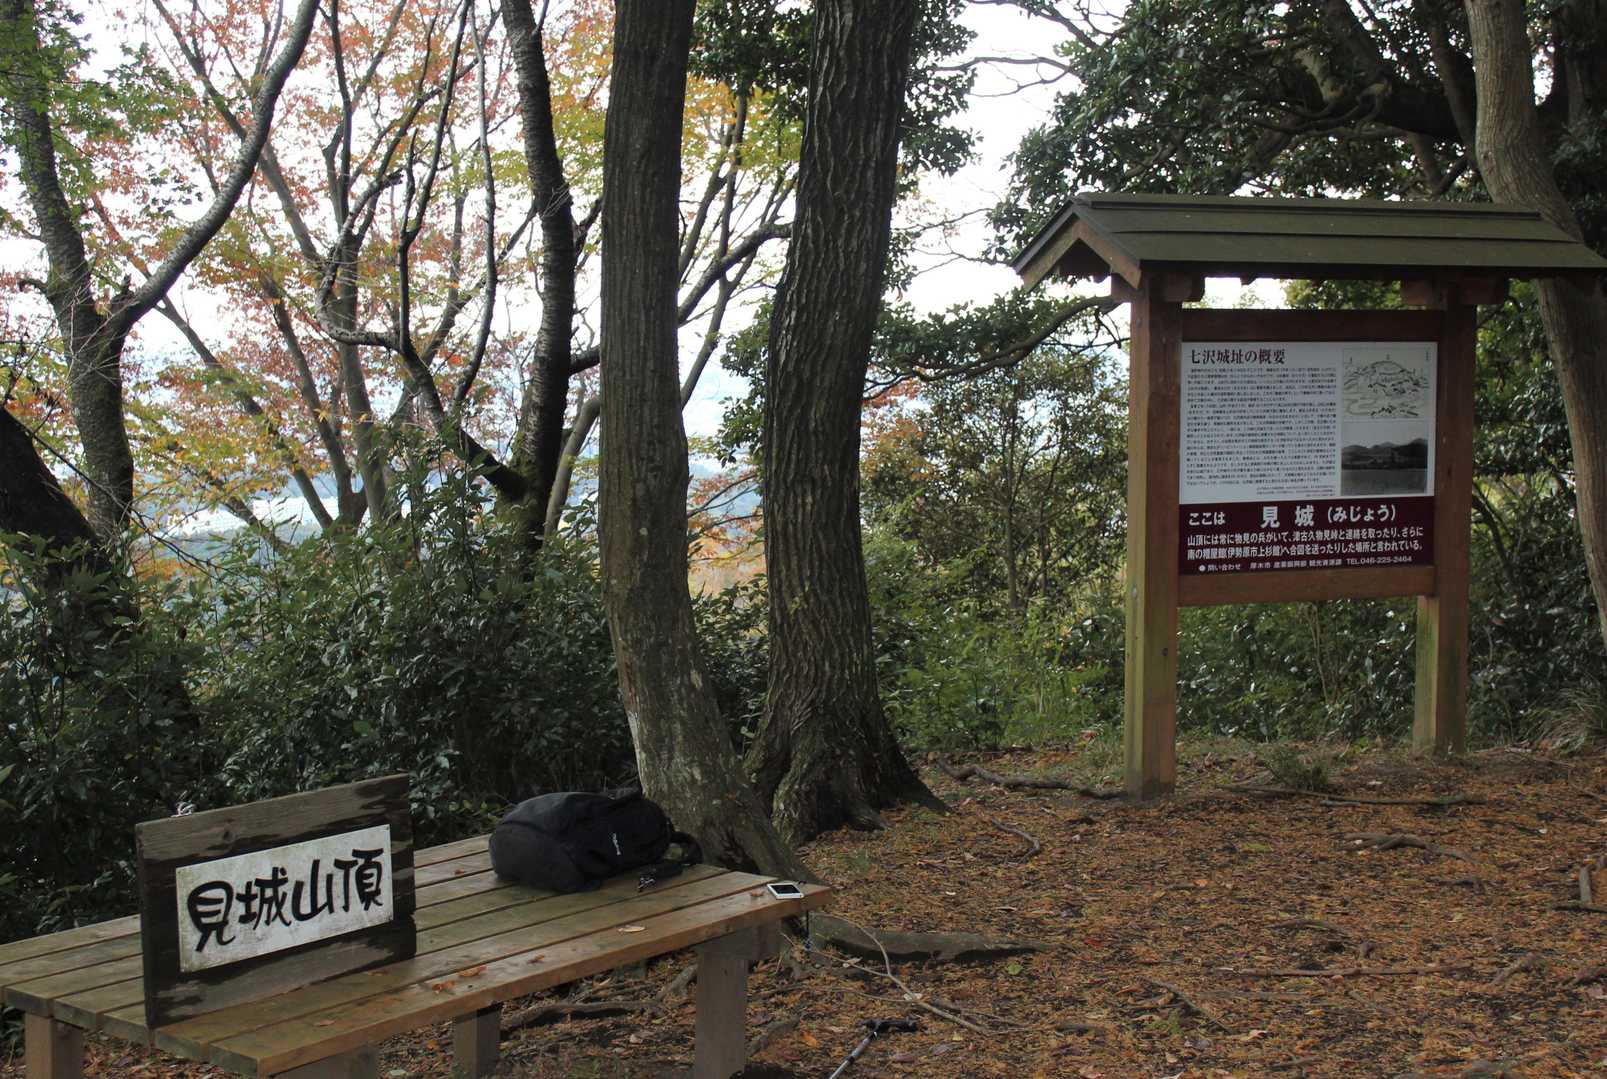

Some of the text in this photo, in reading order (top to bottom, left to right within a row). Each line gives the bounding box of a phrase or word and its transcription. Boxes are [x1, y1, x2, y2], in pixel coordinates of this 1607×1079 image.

[1190, 348, 1286, 365] 七沢城址の概要
[1188, 511, 1226, 526] ここは
[186, 847, 384, 952] 見城山頂
